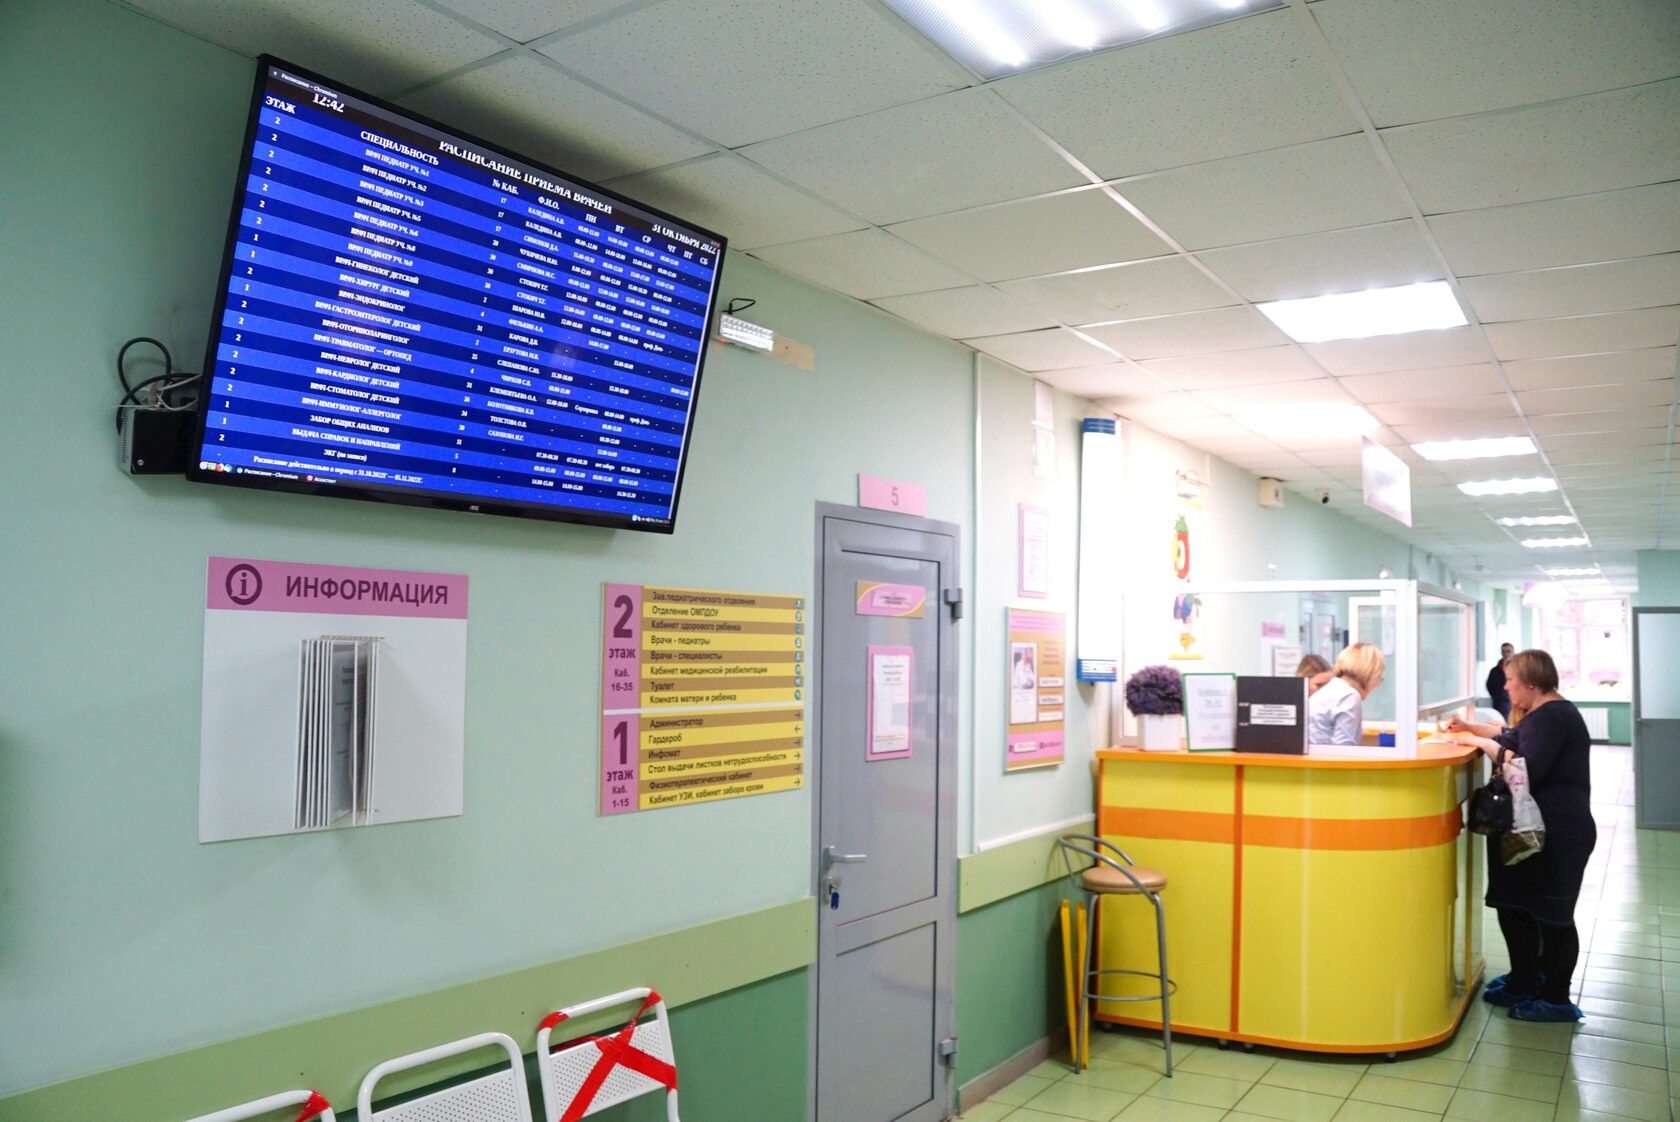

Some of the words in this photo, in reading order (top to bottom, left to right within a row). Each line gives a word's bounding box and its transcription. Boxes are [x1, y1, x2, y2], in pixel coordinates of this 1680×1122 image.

[312, 93, 344, 113] 12:42
[274, 116, 280, 124] 2
[380, 154, 409, 169] ПЕДИАТР
[271, 133, 277, 141] 2
[377, 170, 406, 184] ПЕДИАТР
[438, 140, 521, 179] РАСПИСАНИЕ
[265, 95, 295, 114] ЭТАЖ
[360, 130, 439, 165] СПЕЦИАЛЬНОСТЬ
[501, 182, 518, 194] КАБ.
[537, 196, 559, 209] Ф.И.О.
[585, 213, 597, 223] ПН
[615, 224, 624, 233] ВТ
[642, 235, 651, 243] СР
[667, 244, 676, 253] ЧТ
[683, 250, 693, 259] ПТ
[699, 257, 708, 265] СБ
[268, 150, 274, 158] 2
[374, 185, 404, 200] ПЕДИАТР
[265, 166, 271, 174] 2
[372, 200, 401, 215] ПЕДИАТР
[262, 183, 268, 191] 2
[368, 216, 398, 230] ПЕДИАТР
[259, 200, 265, 208] 2
[366, 231, 395, 245] ПЕДИАТР
[651, 223, 661, 233] 31
[256, 216, 262, 224] 2
[363, 247, 393, 261] ПЕДИАТР
[250, 250, 255, 258] 1
[253, 233, 258, 241] 1
[389, 271, 419, 284] ДЕТСКИЙ
[241, 300, 247, 308] 2
[338, 290, 405, 311] ВРАЧ-ЭНДОКРИНОЛОГ
[238, 317, 244, 325] 2
[235, 333, 241, 341] 2
[370, 362, 400, 373] ДЕТСКИЙ
[232, 350, 238, 358] 2
[369, 377, 400, 389] ДЕТСКИЙ
[227, 383, 233, 391] 2
[309, 382, 370, 398] ВРАЧ-СТОМАТОЛОГ
[369, 393, 400, 404] ДЕТСКИЙ
[225, 400, 229, 408] 1
[310, 414, 331, 424] ЗАБОР
[331, 418, 356, 428] ОБЩИХ
[356, 422, 389, 433] АНАЛИЗОВ
[219, 433, 224, 441] 2
[291, 428, 319, 438] ВЫДАЧА
[319, 432, 350, 442] СПРАВОК
[891, 486, 899, 506] 5
[286, 575, 448, 607] ИНФОРМАЦИЯ
[613, 594, 633, 638] 2
[652, 606, 689, 616] Отделение
[690, 607, 719, 617] ОМПДОУ
[651, 620, 679, 629] Кабинет
[681, 622, 714, 631] здорового
[716, 623, 741, 631] ребенка
[651, 635, 672, 645] Врачи
[678, 637, 710, 645] педиатры
[609, 648, 636, 659] этаж
[651, 651, 672, 660] Врачи
[678, 652, 722, 660] специалисты
[614, 668, 630, 677] Каб.
[650, 666, 678, 675] Кабинет
[680, 666, 723, 675] медицинской
[725, 666, 767, 674] реабилитации
[611, 682, 633, 691] 16-35
[651, 682, 674, 690] Туалет
[650, 695, 680, 704] Комната
[682, 694, 705, 703] матери
[711, 693, 736, 702] ребенка
[650, 719, 703, 729] Администратор
[613, 721, 628, 765] 1
[649, 733, 682, 744] Гардероб
[648, 750, 680, 759] Инфомат
[648, 764, 666, 774] Стол
[668, 763, 694, 773] выдачи
[696, 760, 722, 769] листков
[724, 753, 787, 767] нетрудоспособности
[606, 770, 633, 782] этаж
[649, 774, 726, 789] Физиотерапевтический
[728, 771, 753, 780] кабинет
[612, 785, 628, 794] Каб.
[649, 794, 678, 804] Кабинет
[696, 789, 721, 799] кабинет
[723, 786, 744, 795] забора
[746, 784, 764, 792] крови
[613, 799, 629, 808] 1-15
